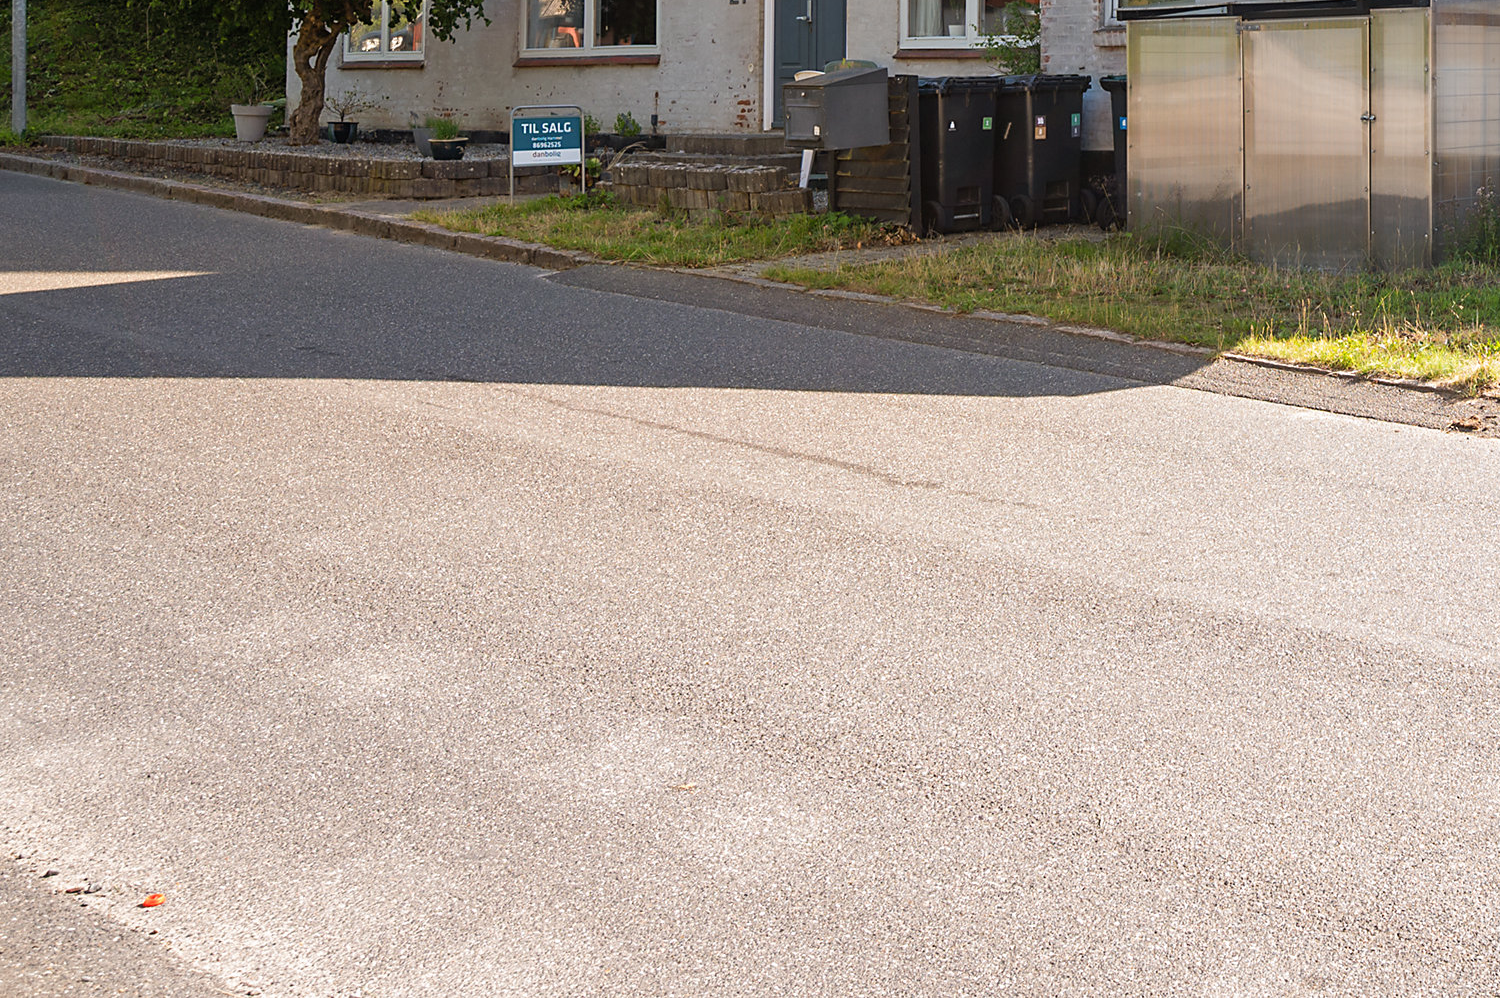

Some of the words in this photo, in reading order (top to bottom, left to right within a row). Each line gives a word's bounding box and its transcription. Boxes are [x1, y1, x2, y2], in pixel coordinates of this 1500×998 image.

[521, 123, 539, 134] TIL
[542, 122, 572, 133] SALG
[532, 141, 562, 149] 86962525
